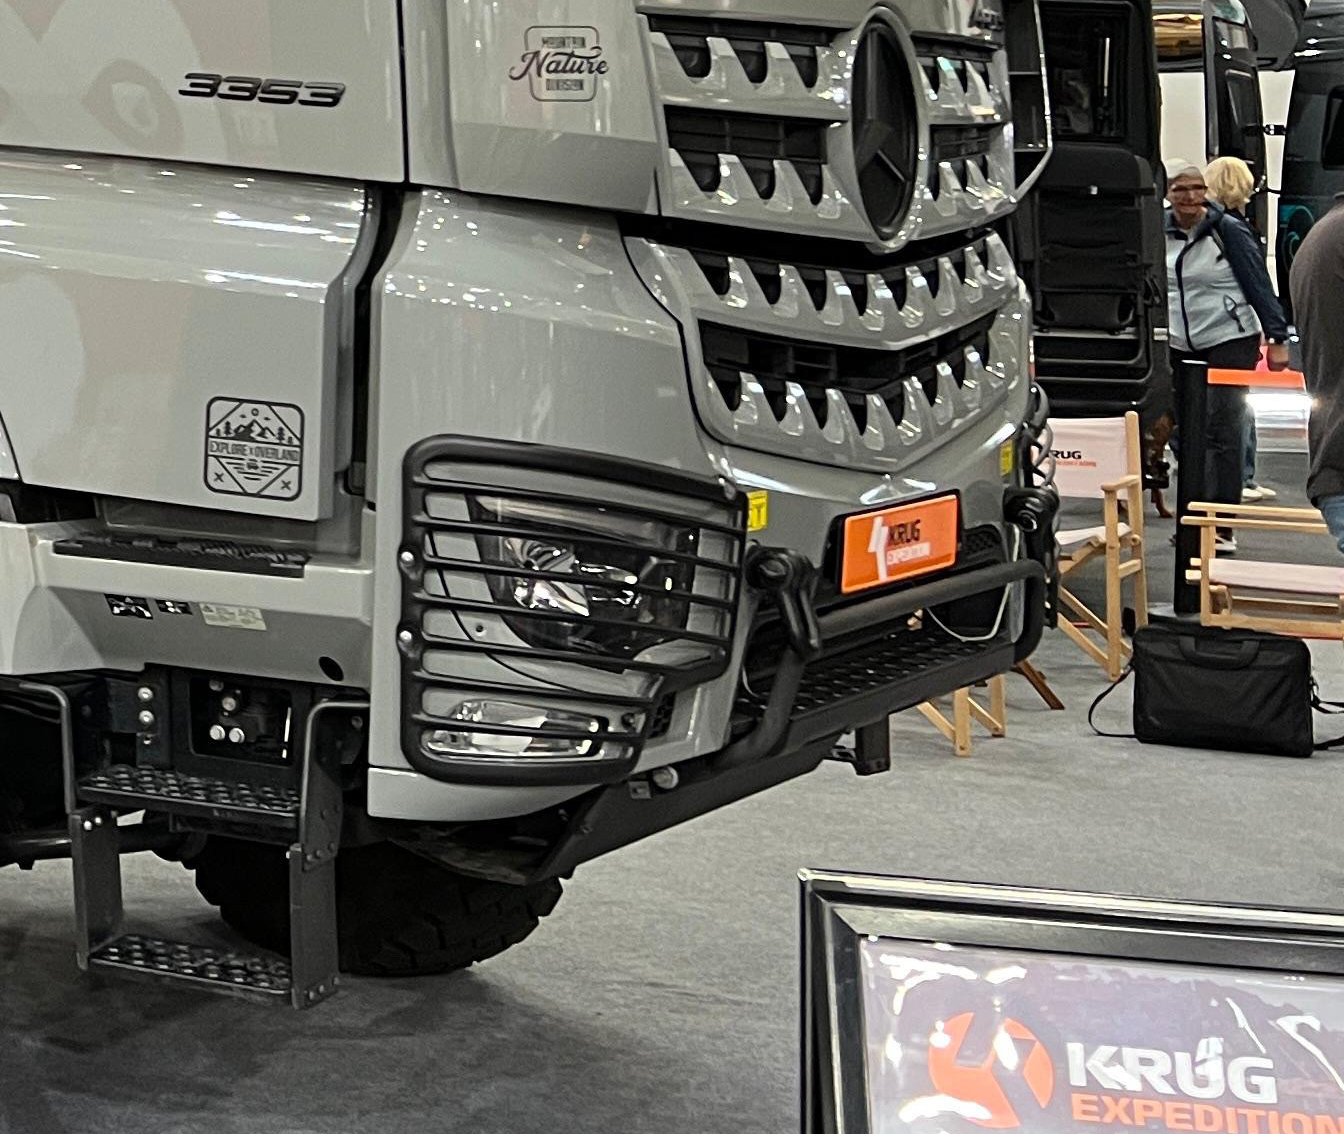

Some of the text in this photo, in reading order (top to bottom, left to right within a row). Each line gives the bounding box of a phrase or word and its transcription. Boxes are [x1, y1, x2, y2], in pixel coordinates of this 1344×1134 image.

[508, 46, 609, 80] Nature
[178, 72, 346, 107] 3353
[1049, 450, 1082, 459] RUG
[888, 519, 921, 545] KRUG
[1066, 1040, 1278, 1104] KRUG
